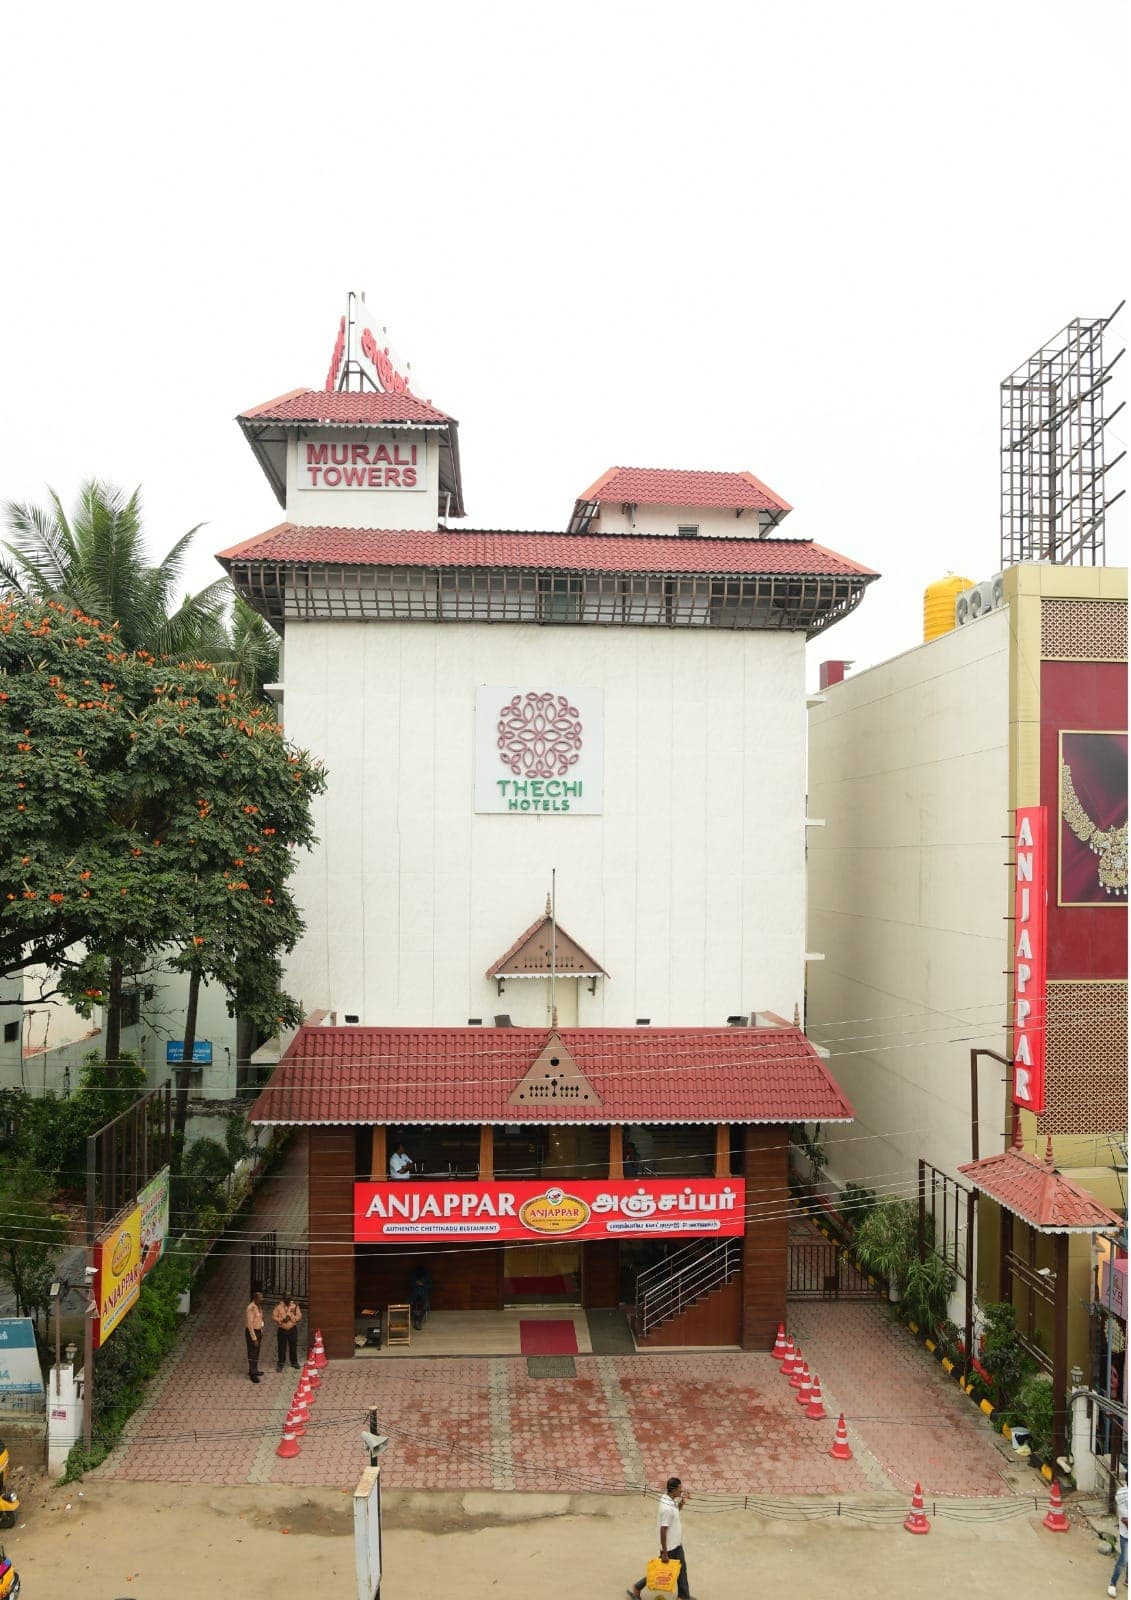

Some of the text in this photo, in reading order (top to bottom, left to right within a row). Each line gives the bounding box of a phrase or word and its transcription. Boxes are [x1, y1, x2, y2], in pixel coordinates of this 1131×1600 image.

[307, 443, 417, 465] MURALI
[307, 467, 417, 487] TOWERS
[497, 780, 583, 797] THECHI
[508, 799, 570, 811] HOTELS
[1015, 816, 1034, 1101] ANJAPPAR
[364, 1192, 517, 1221] ANJAPPAR
[530, 1208, 580, 1218] ANJAPPAR
[591, 1187, 737, 1218] அஞ்சப்பர்
[102, 1263, 139, 1316] ANJAPPAR
